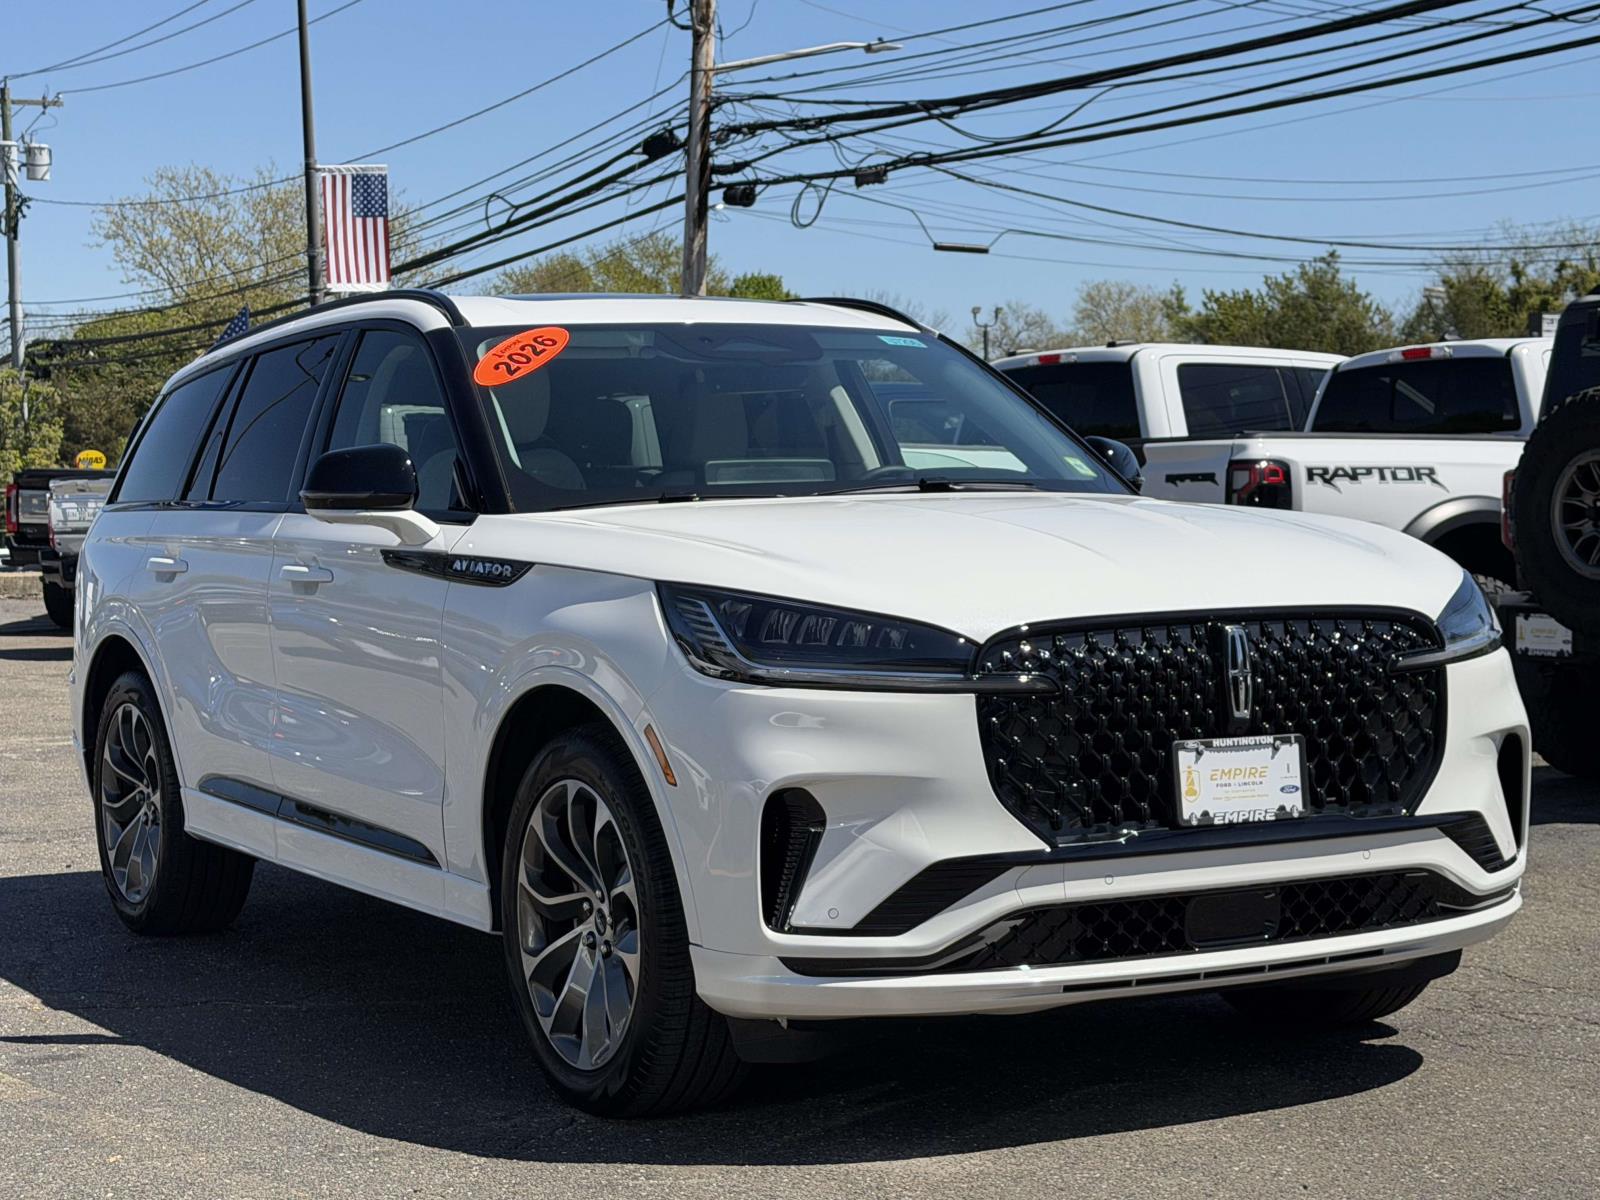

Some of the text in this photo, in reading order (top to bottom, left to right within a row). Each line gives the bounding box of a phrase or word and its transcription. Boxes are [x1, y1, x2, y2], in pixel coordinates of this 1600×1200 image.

[493, 335, 558, 377] 2026
[1306, 465, 1451, 494] RAPTOR
[452, 559, 512, 577] AVIATOR
[1213, 736, 1274, 747] HUNTINGTON
[1210, 766, 1268, 781] EMPIRE
[1214, 809, 1275, 824] EMPIRE
